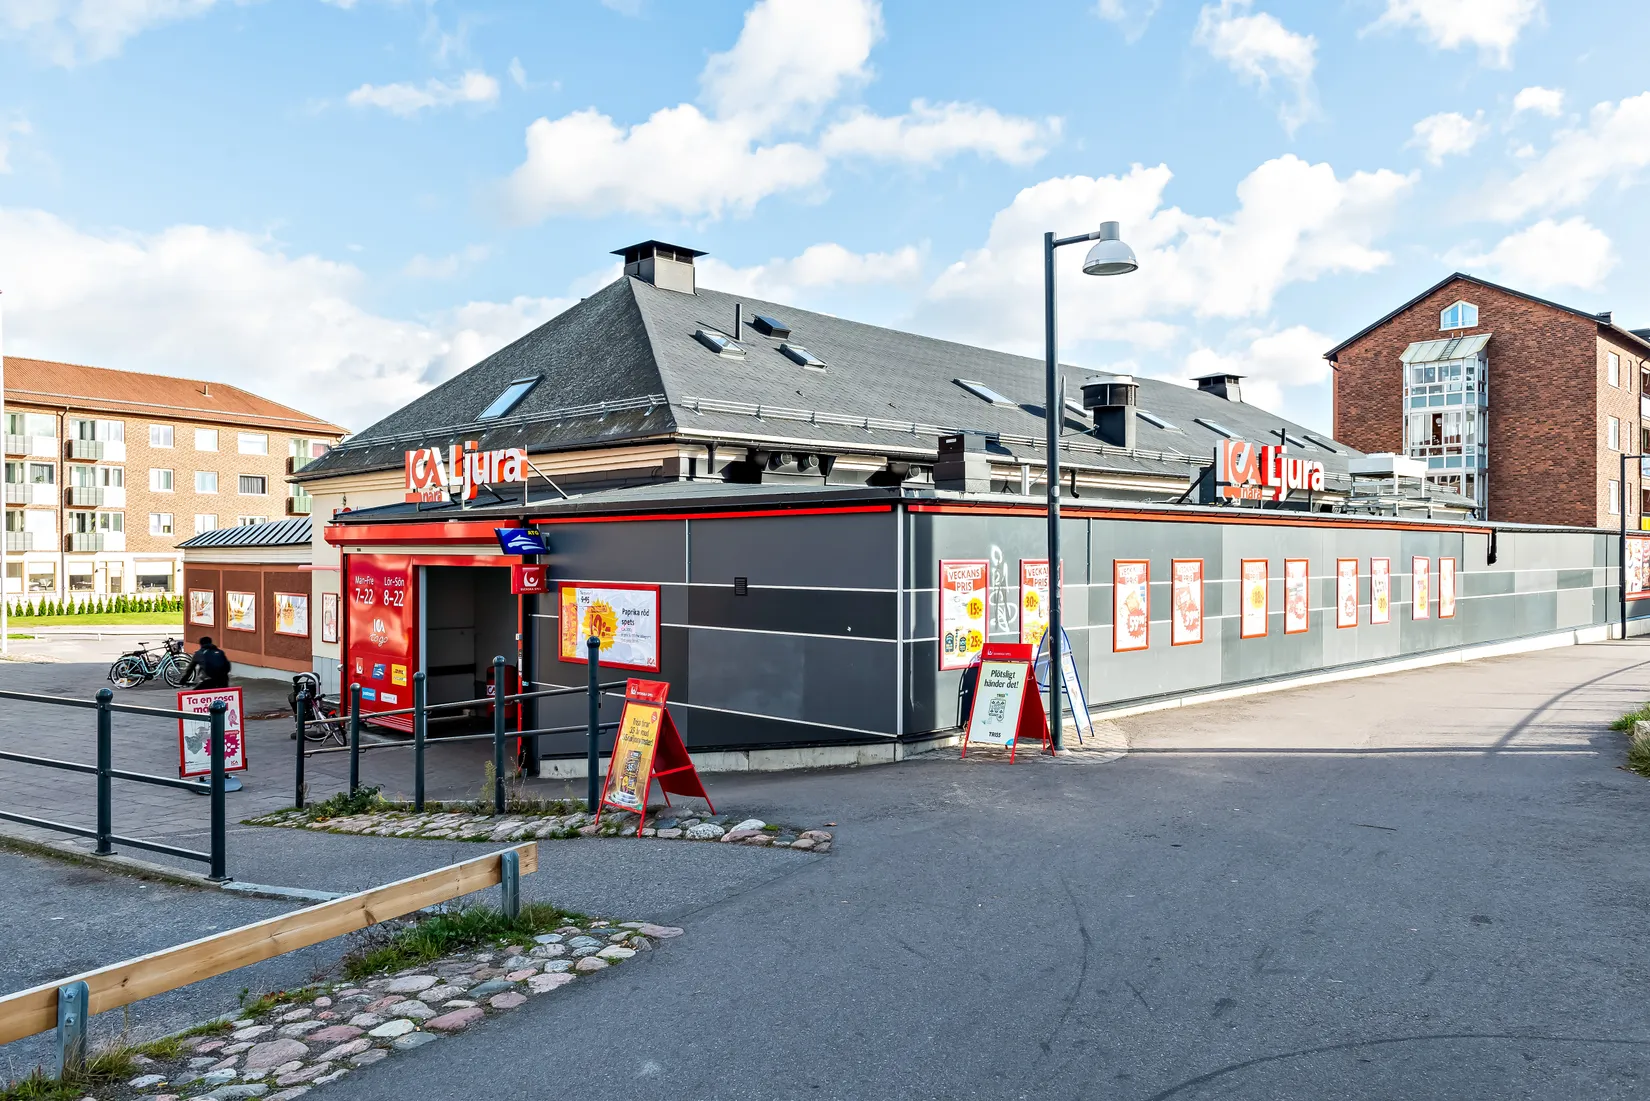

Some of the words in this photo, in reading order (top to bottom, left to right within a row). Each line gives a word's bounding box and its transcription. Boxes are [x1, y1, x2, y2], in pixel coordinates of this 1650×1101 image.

[1220, 439, 1263, 484] ICA
[405, 447, 446, 489] ICA
[449, 441, 528, 500] Ljura
[1264, 445, 1325, 502] Ljura
[422, 488, 445, 502] nära
[1240, 486, 1263, 500] nära
[948, 568, 980, 580] VECKANS
[1028, 567, 1048, 576] VECKA
[384, 576, 404, 586] Lör-Sön
[956, 582, 972, 592] PRIS
[1034, 578, 1048, 587] PRIS
[355, 588, 374, 605] 7-22
[384, 590, 404, 606] 8-22
[1026, 596, 1038, 608] 30:-
[622, 608, 640, 617] Paprika
[641, 608, 650, 617] röd
[970, 602, 982, 616] 15:-
[373, 618, 386, 634] ICA
[970, 636, 982, 648] 25:-
[990, 669, 1016, 680] Plötsligt
[984, 679, 1005, 688] händer
[1006, 680, 1019, 689] det!
